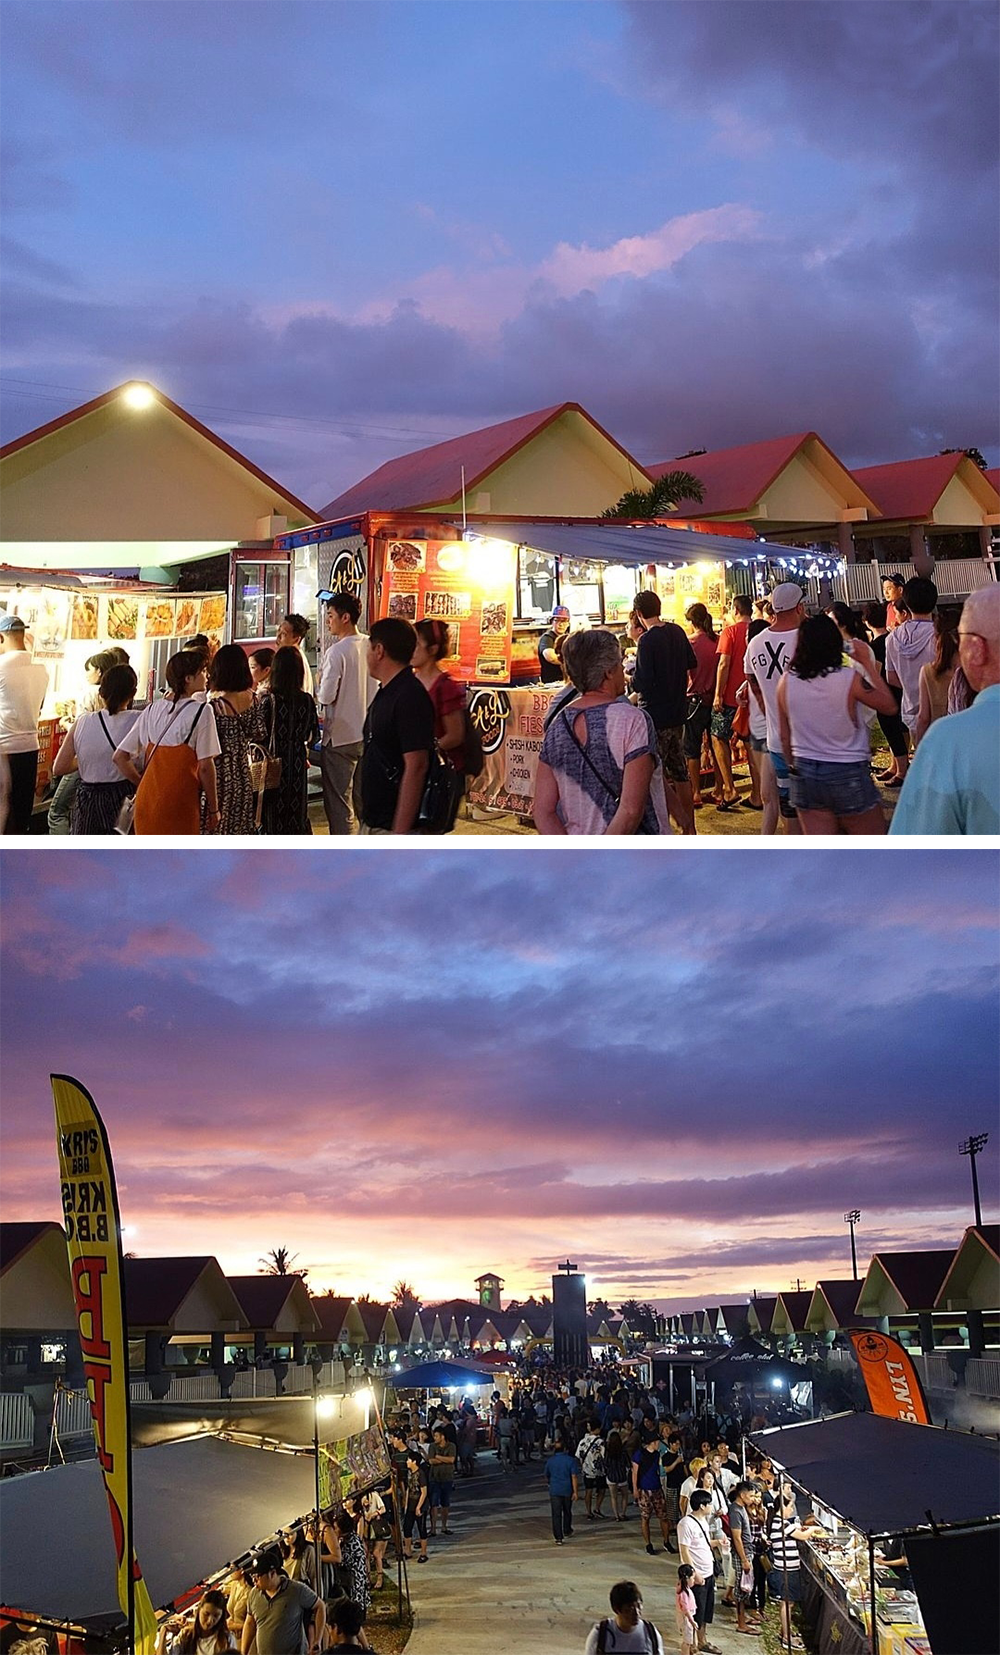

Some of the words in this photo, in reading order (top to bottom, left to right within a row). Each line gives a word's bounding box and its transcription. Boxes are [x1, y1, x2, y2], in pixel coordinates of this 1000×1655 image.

[520, 716, 545, 734] FIES
[509, 739, 525, 750] SHISH
[512, 754, 524, 764] PORK
[62, 1129, 98, 1157] KRIS
